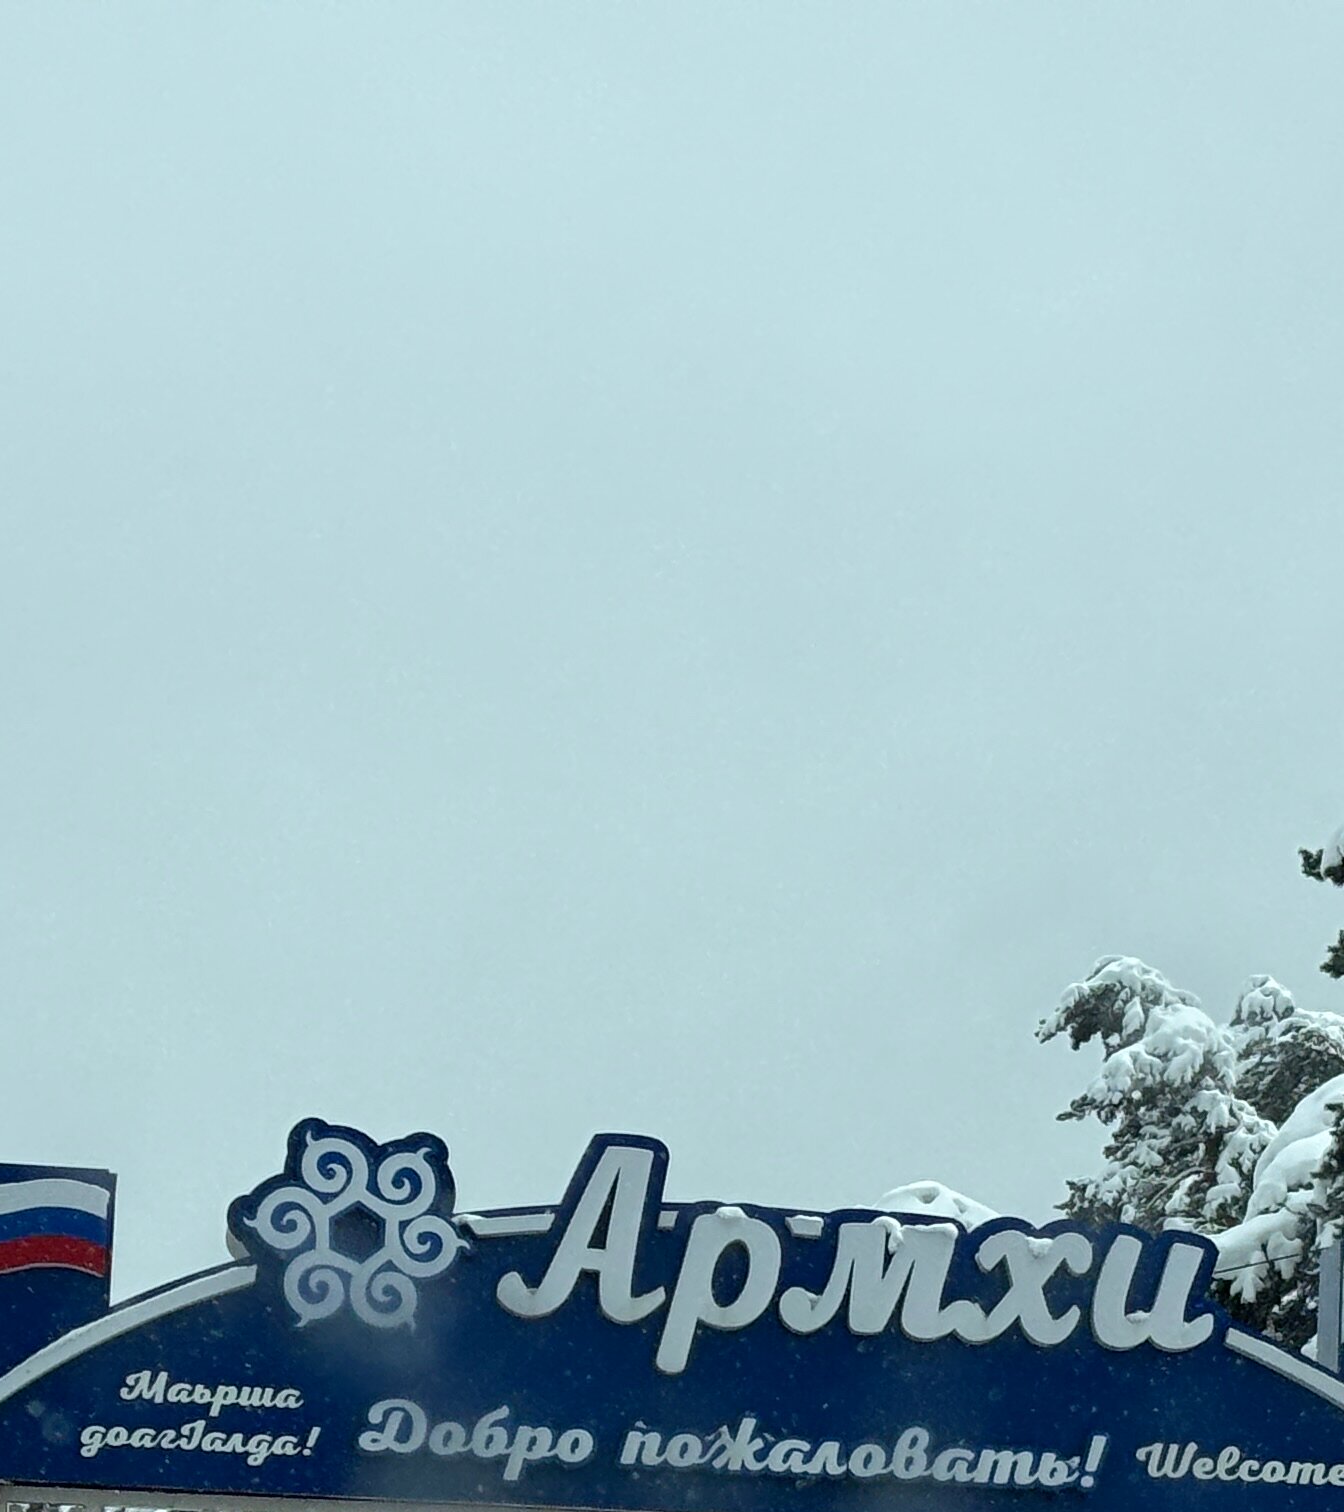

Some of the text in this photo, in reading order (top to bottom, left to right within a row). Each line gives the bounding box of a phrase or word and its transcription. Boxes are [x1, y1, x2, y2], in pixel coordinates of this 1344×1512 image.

[495, 1144, 1215, 1375] Армхи
[120, 1370, 304, 1417] Маьрша
[358, 1397, 1109, 1489] Добро пожаловать!
